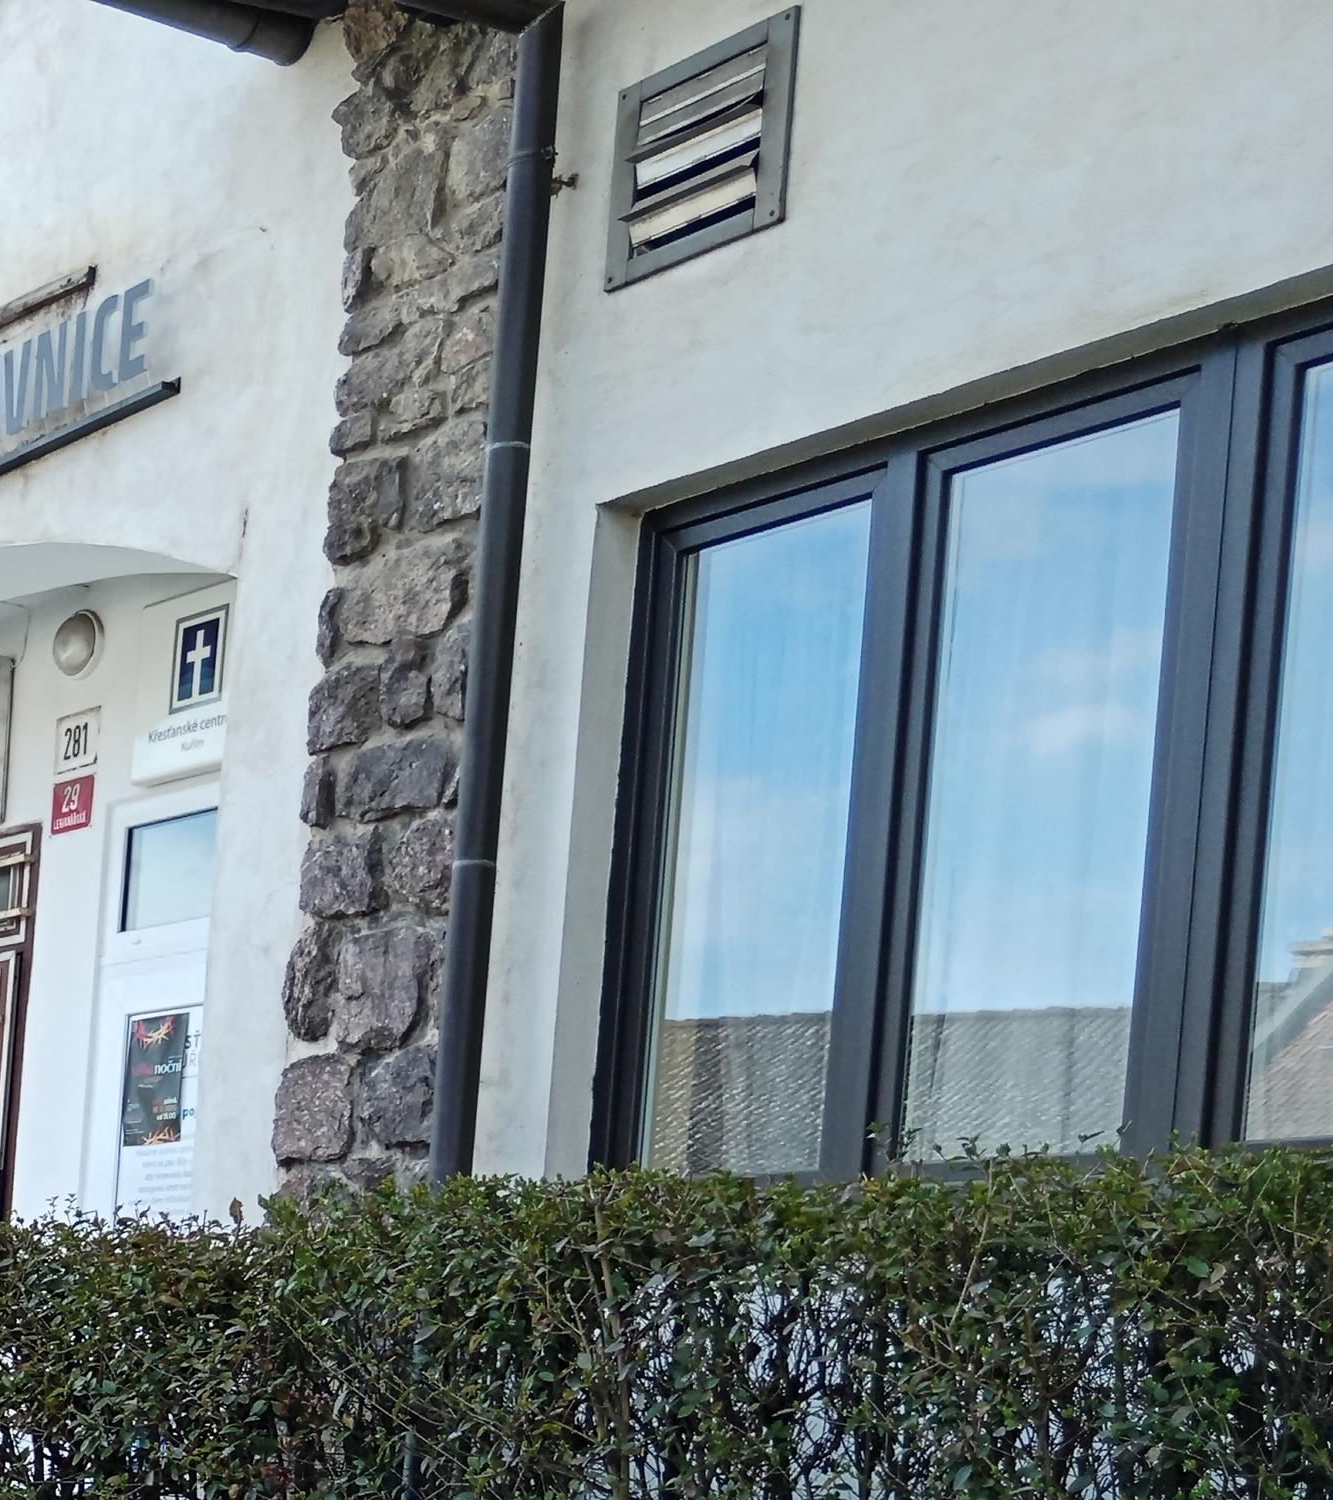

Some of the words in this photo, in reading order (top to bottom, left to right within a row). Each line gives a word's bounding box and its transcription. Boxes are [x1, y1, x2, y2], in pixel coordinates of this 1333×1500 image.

[199, 714, 227, 730] centr
[63, 722, 88, 760] 281
[61, 783, 81, 813] 29
